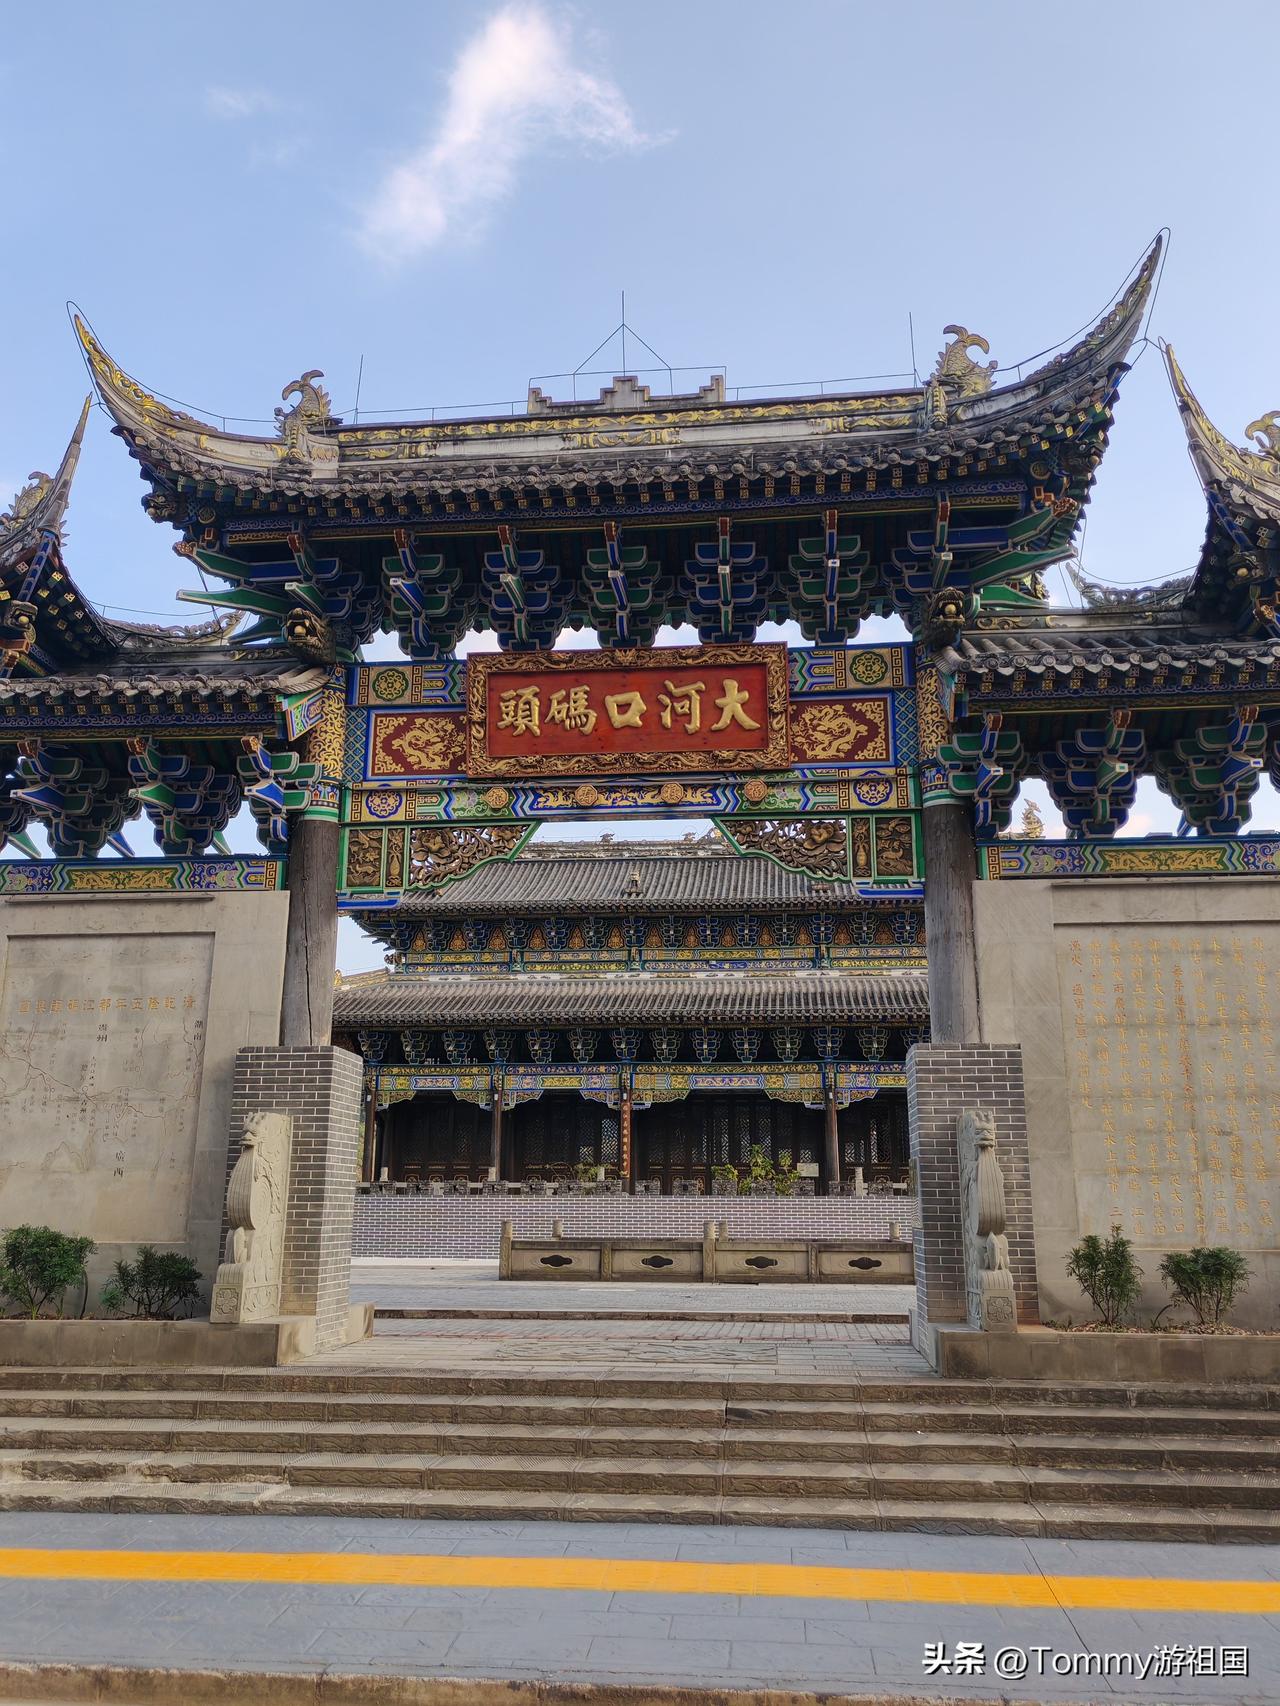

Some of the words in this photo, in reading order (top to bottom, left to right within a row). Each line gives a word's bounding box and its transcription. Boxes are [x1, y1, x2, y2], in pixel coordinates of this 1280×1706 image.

[497, 678, 761, 737] 大河口碼頭
